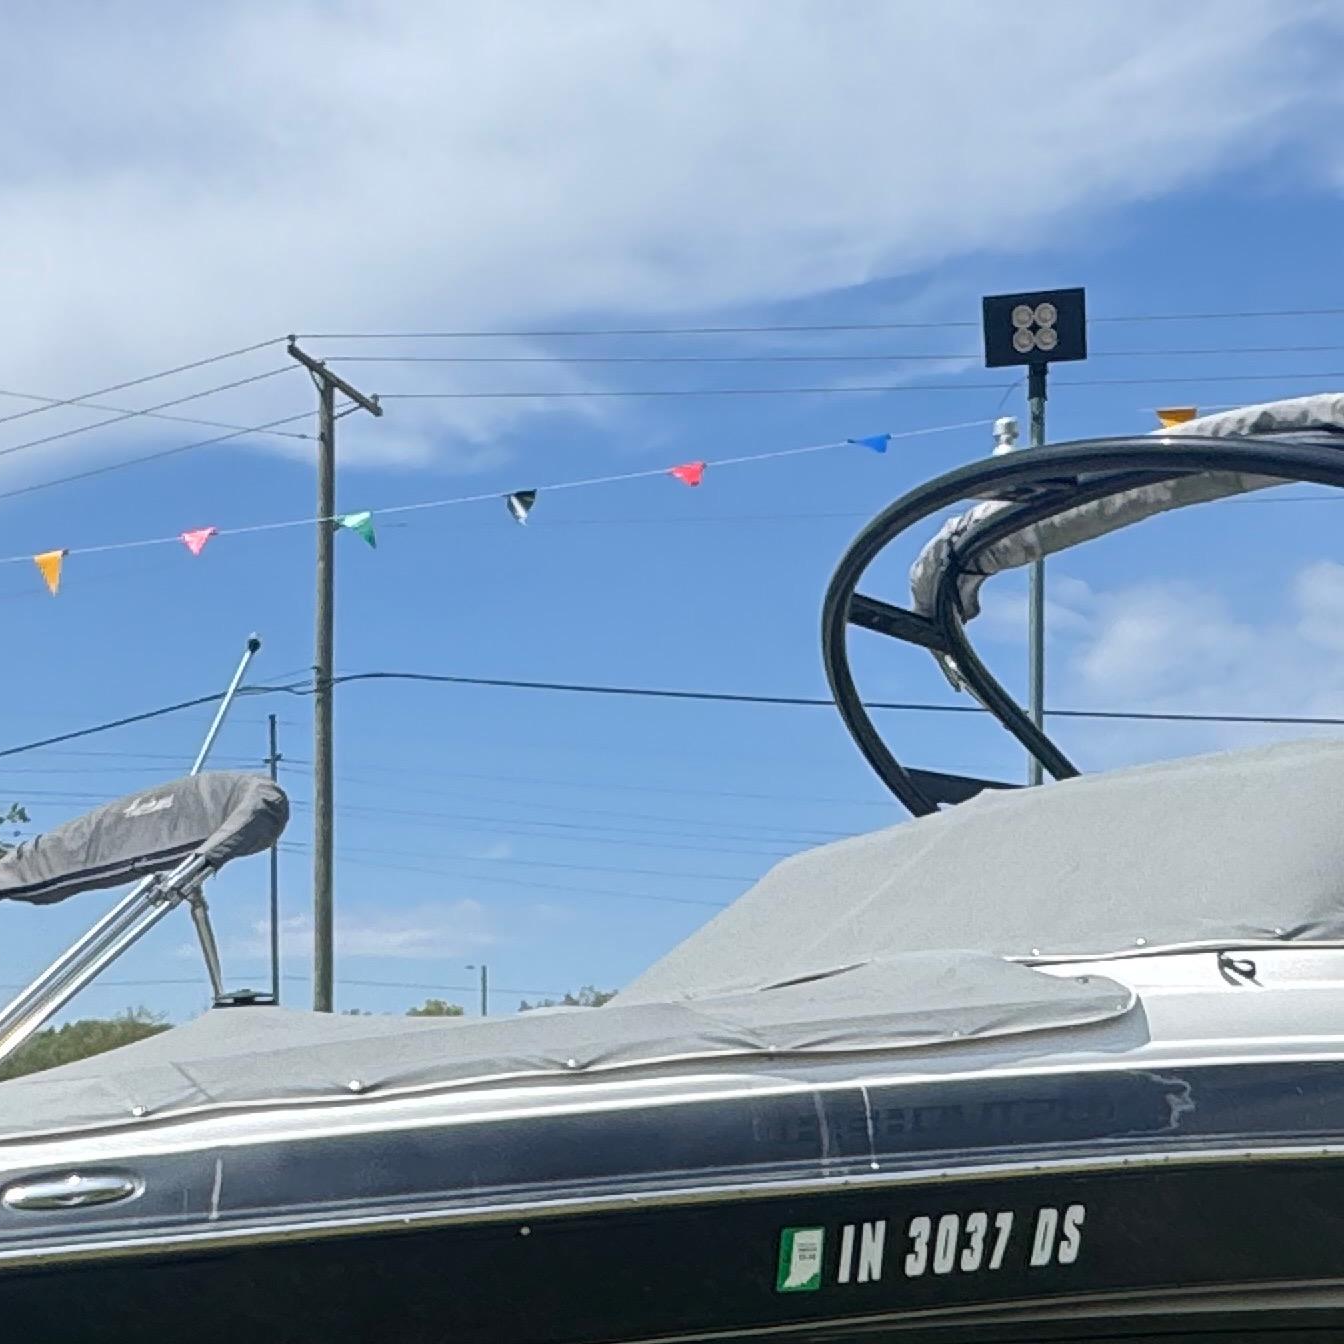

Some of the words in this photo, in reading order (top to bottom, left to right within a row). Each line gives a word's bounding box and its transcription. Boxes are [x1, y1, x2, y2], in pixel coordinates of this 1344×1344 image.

[837, 1219, 886, 1284] IN
[905, 1210, 1014, 1278] 3037
[1029, 1204, 1086, 1267] DS
